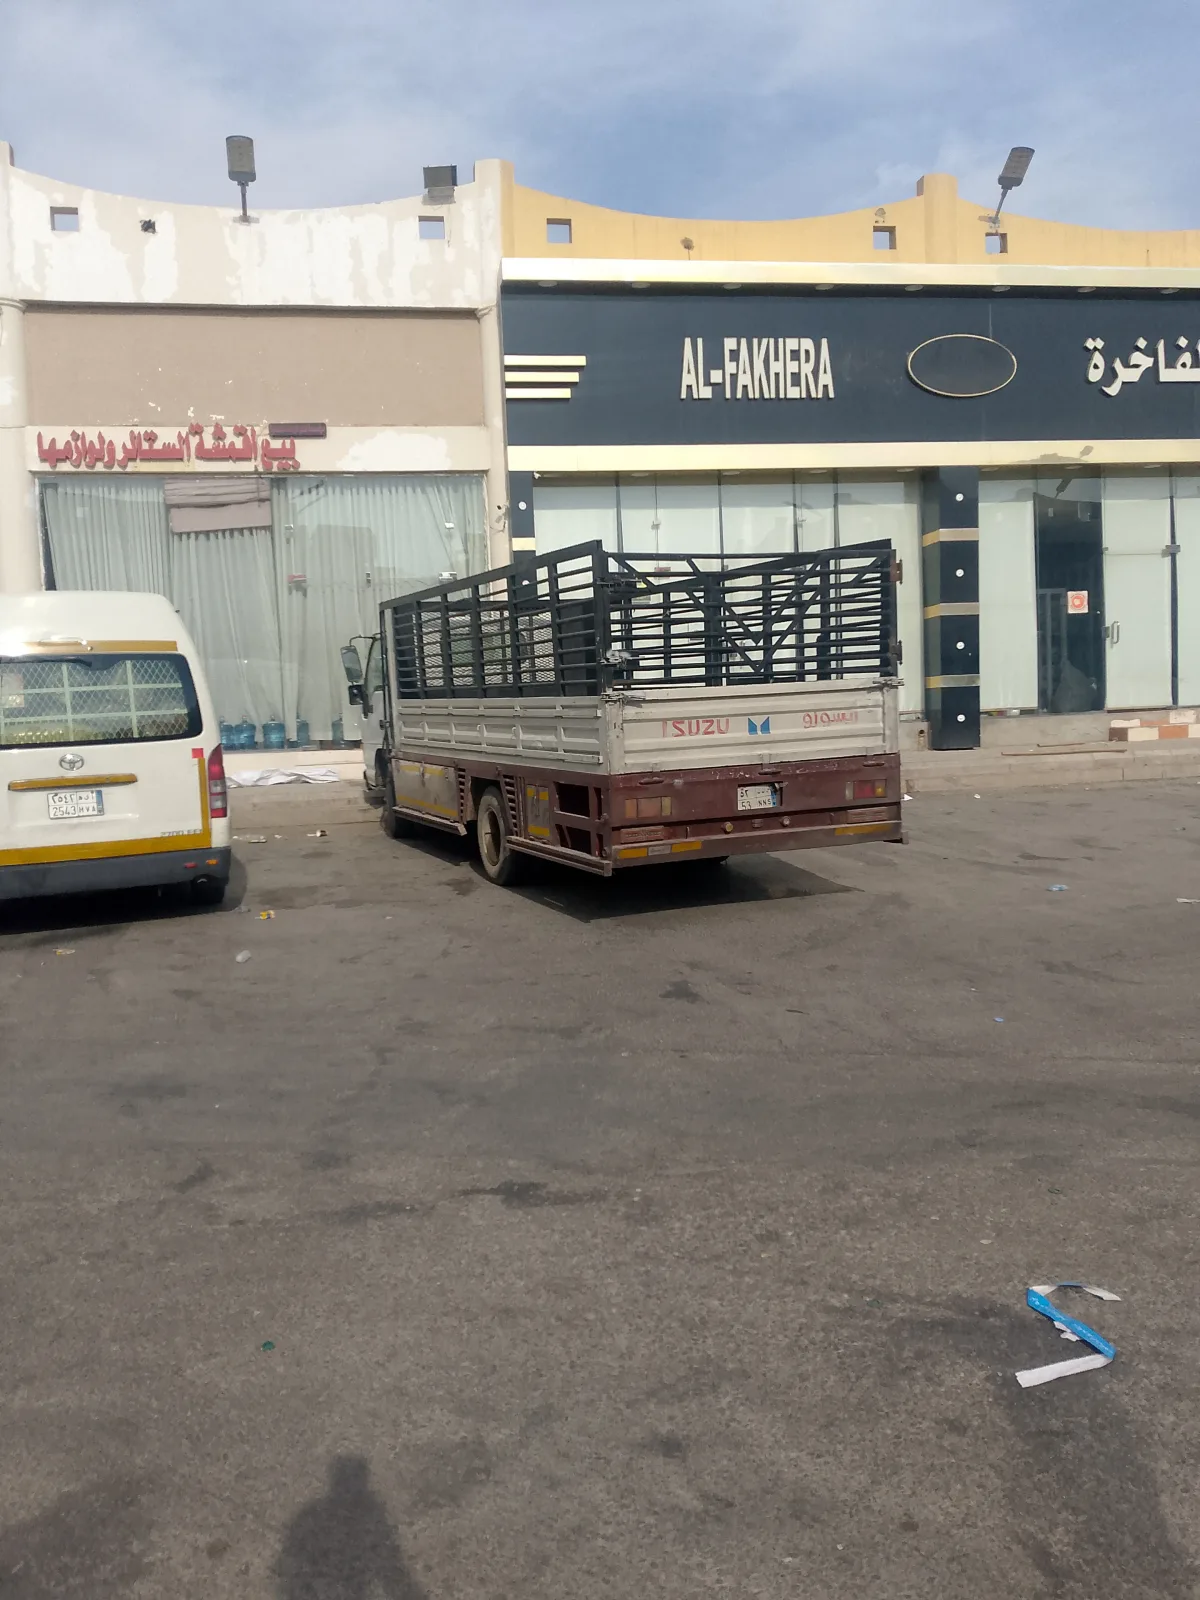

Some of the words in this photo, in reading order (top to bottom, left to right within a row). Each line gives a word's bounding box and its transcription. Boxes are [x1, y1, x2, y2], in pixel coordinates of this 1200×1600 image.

[680, 337, 835, 399] AL-FAKHERA
[261, 436, 301, 471] بيع
[662, 718, 730, 738] ISUZU
[52, 805, 77, 817] 2543
